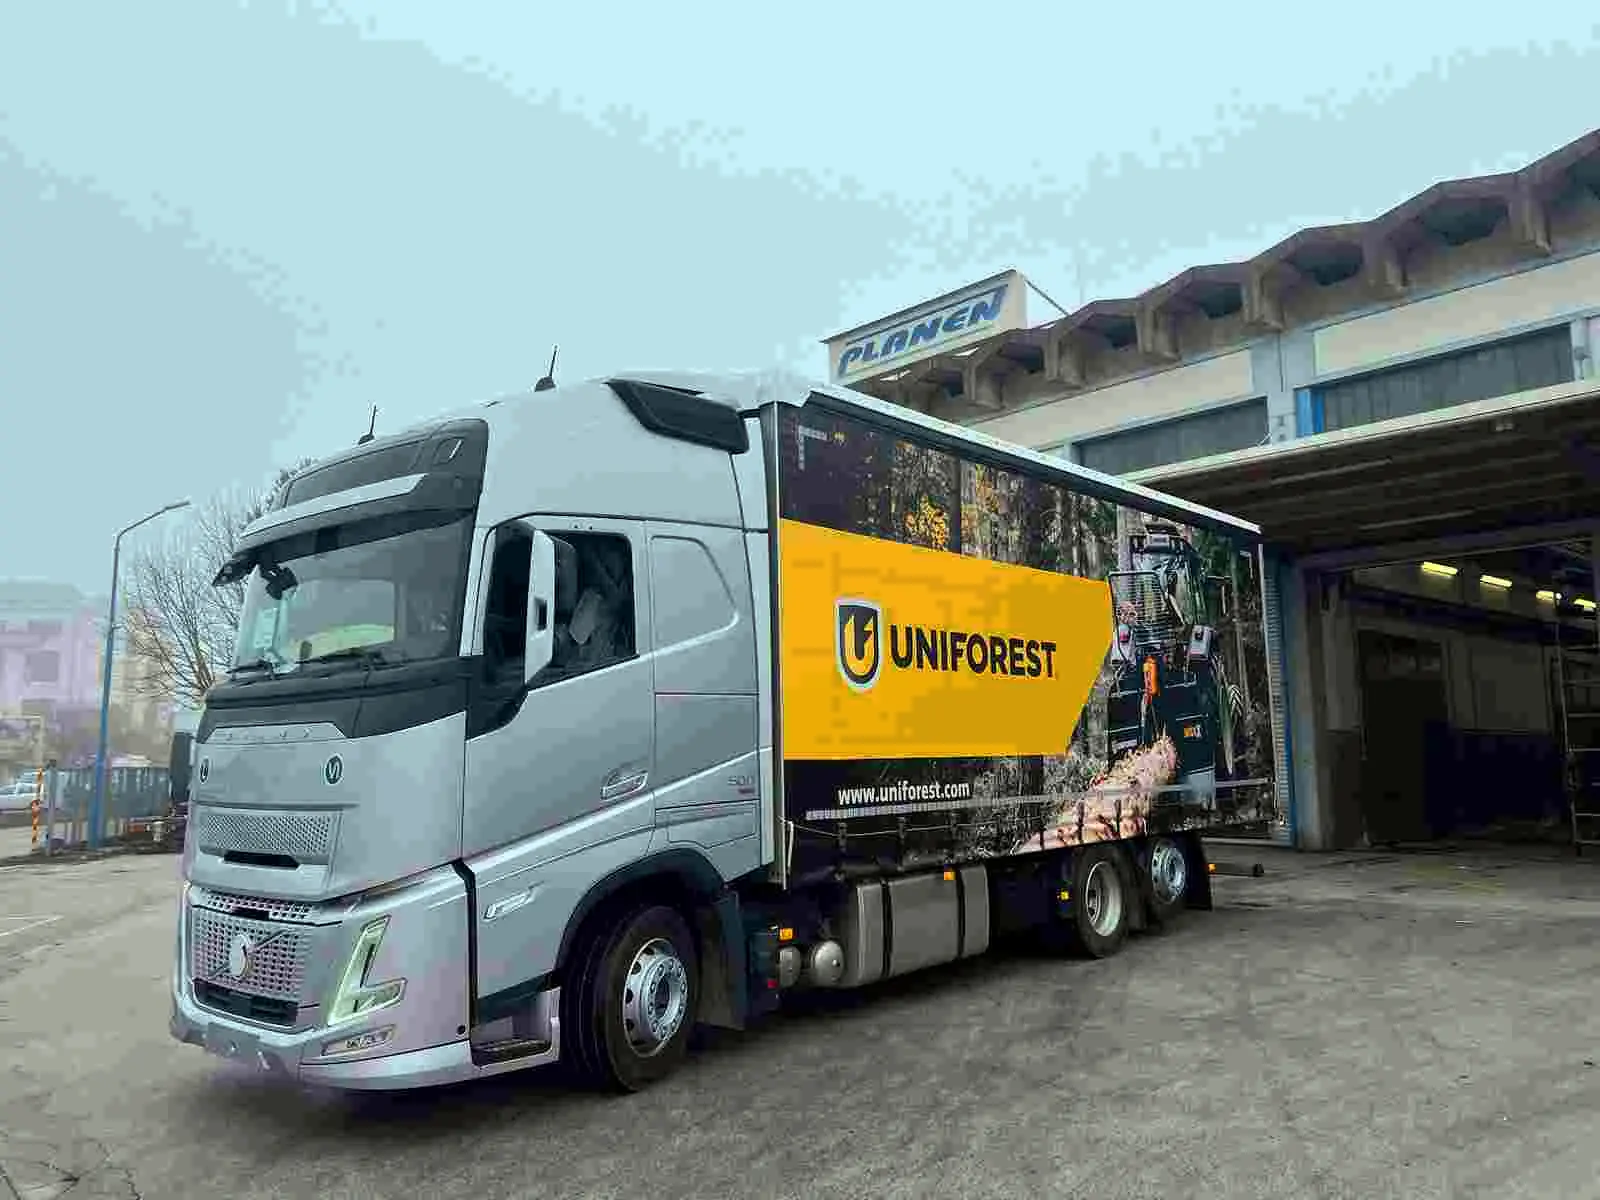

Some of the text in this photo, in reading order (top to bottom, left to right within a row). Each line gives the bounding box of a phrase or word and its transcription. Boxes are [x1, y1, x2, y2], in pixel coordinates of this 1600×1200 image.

[838, 285, 1006, 377] PLANEN
[889, 624, 1057, 678] UNIFOREST
[838, 781, 970, 805] www.uniforest.com
